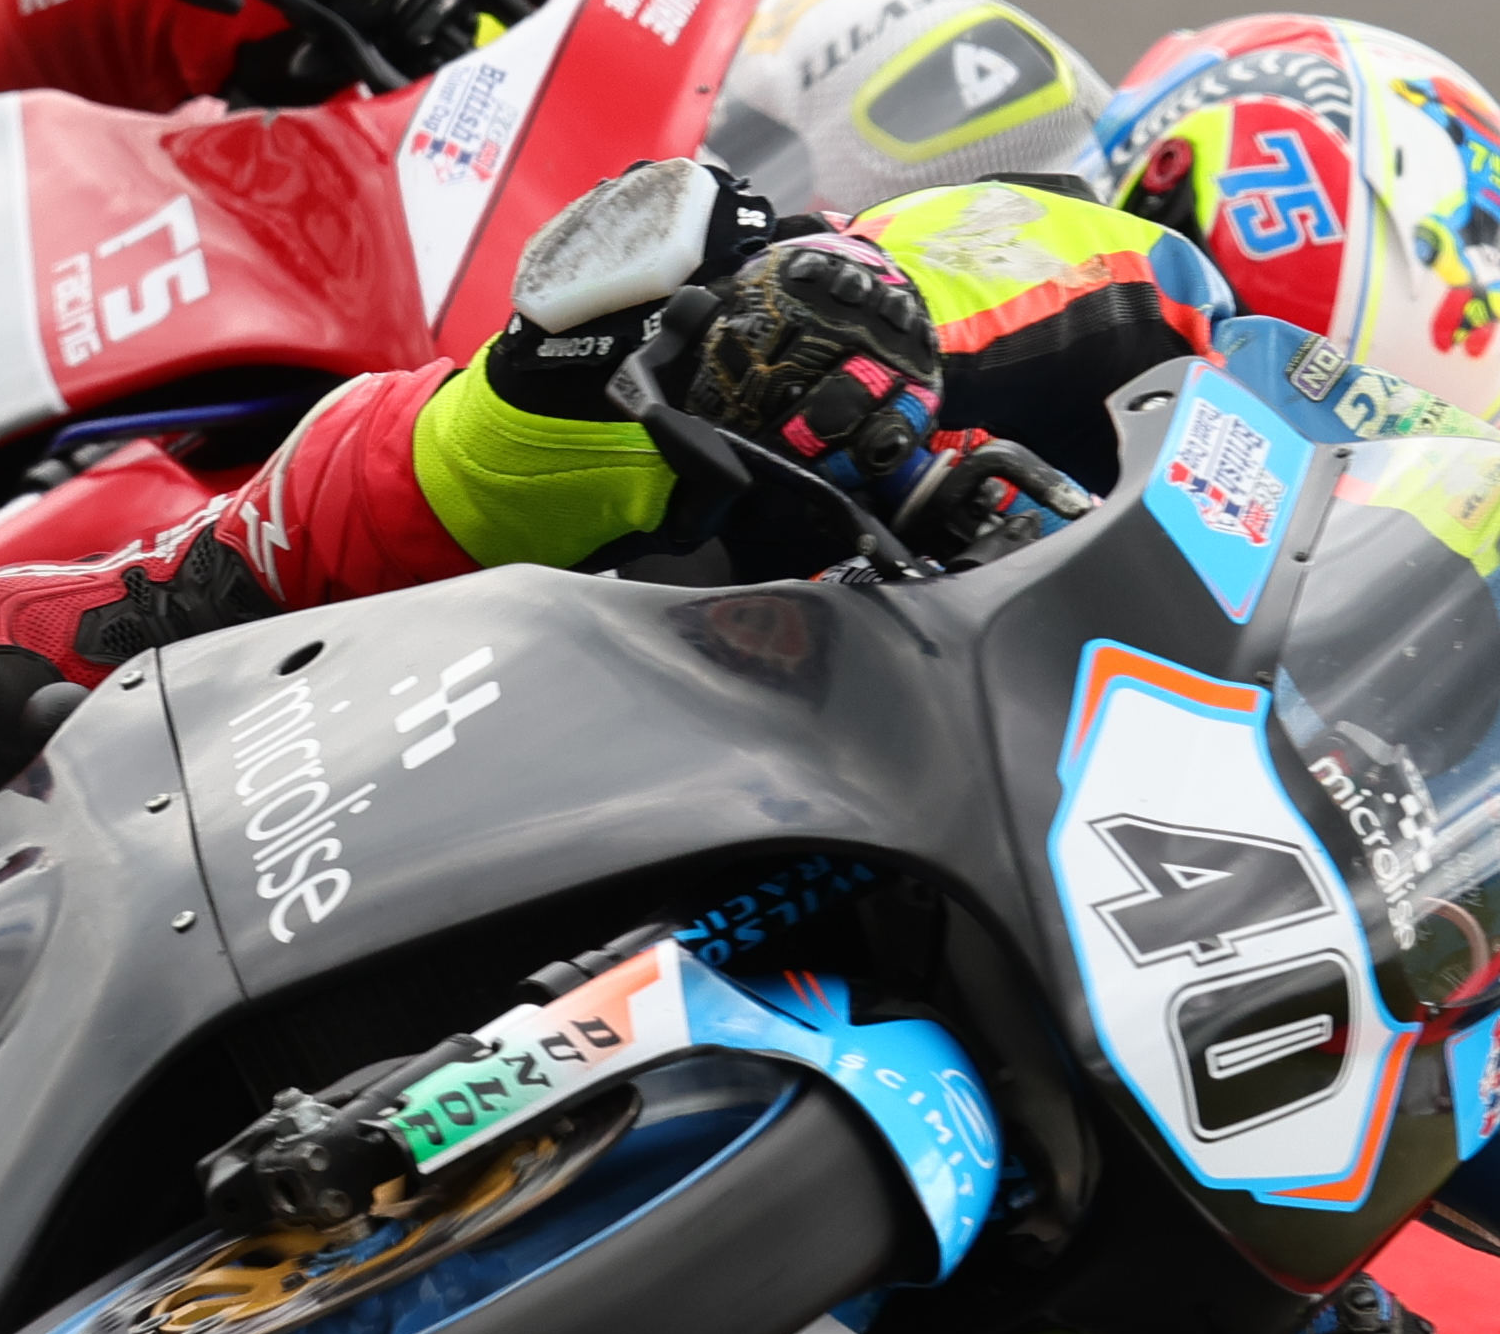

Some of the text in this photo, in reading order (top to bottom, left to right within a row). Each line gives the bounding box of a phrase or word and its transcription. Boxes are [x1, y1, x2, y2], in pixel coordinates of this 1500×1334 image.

[450, 63, 507, 144] British
[1212, 128, 1347, 261] 75
[1212, 419, 1266, 496] British
[228, 677, 377, 944] microlise
[1308, 755, 1418, 951] microlise
[671, 855, 832, 943] RACIN
[699, 863, 876, 967] WILSO
[1085, 812, 1362, 1143] 40
[404, 1016, 623, 1146] DUNLOP
